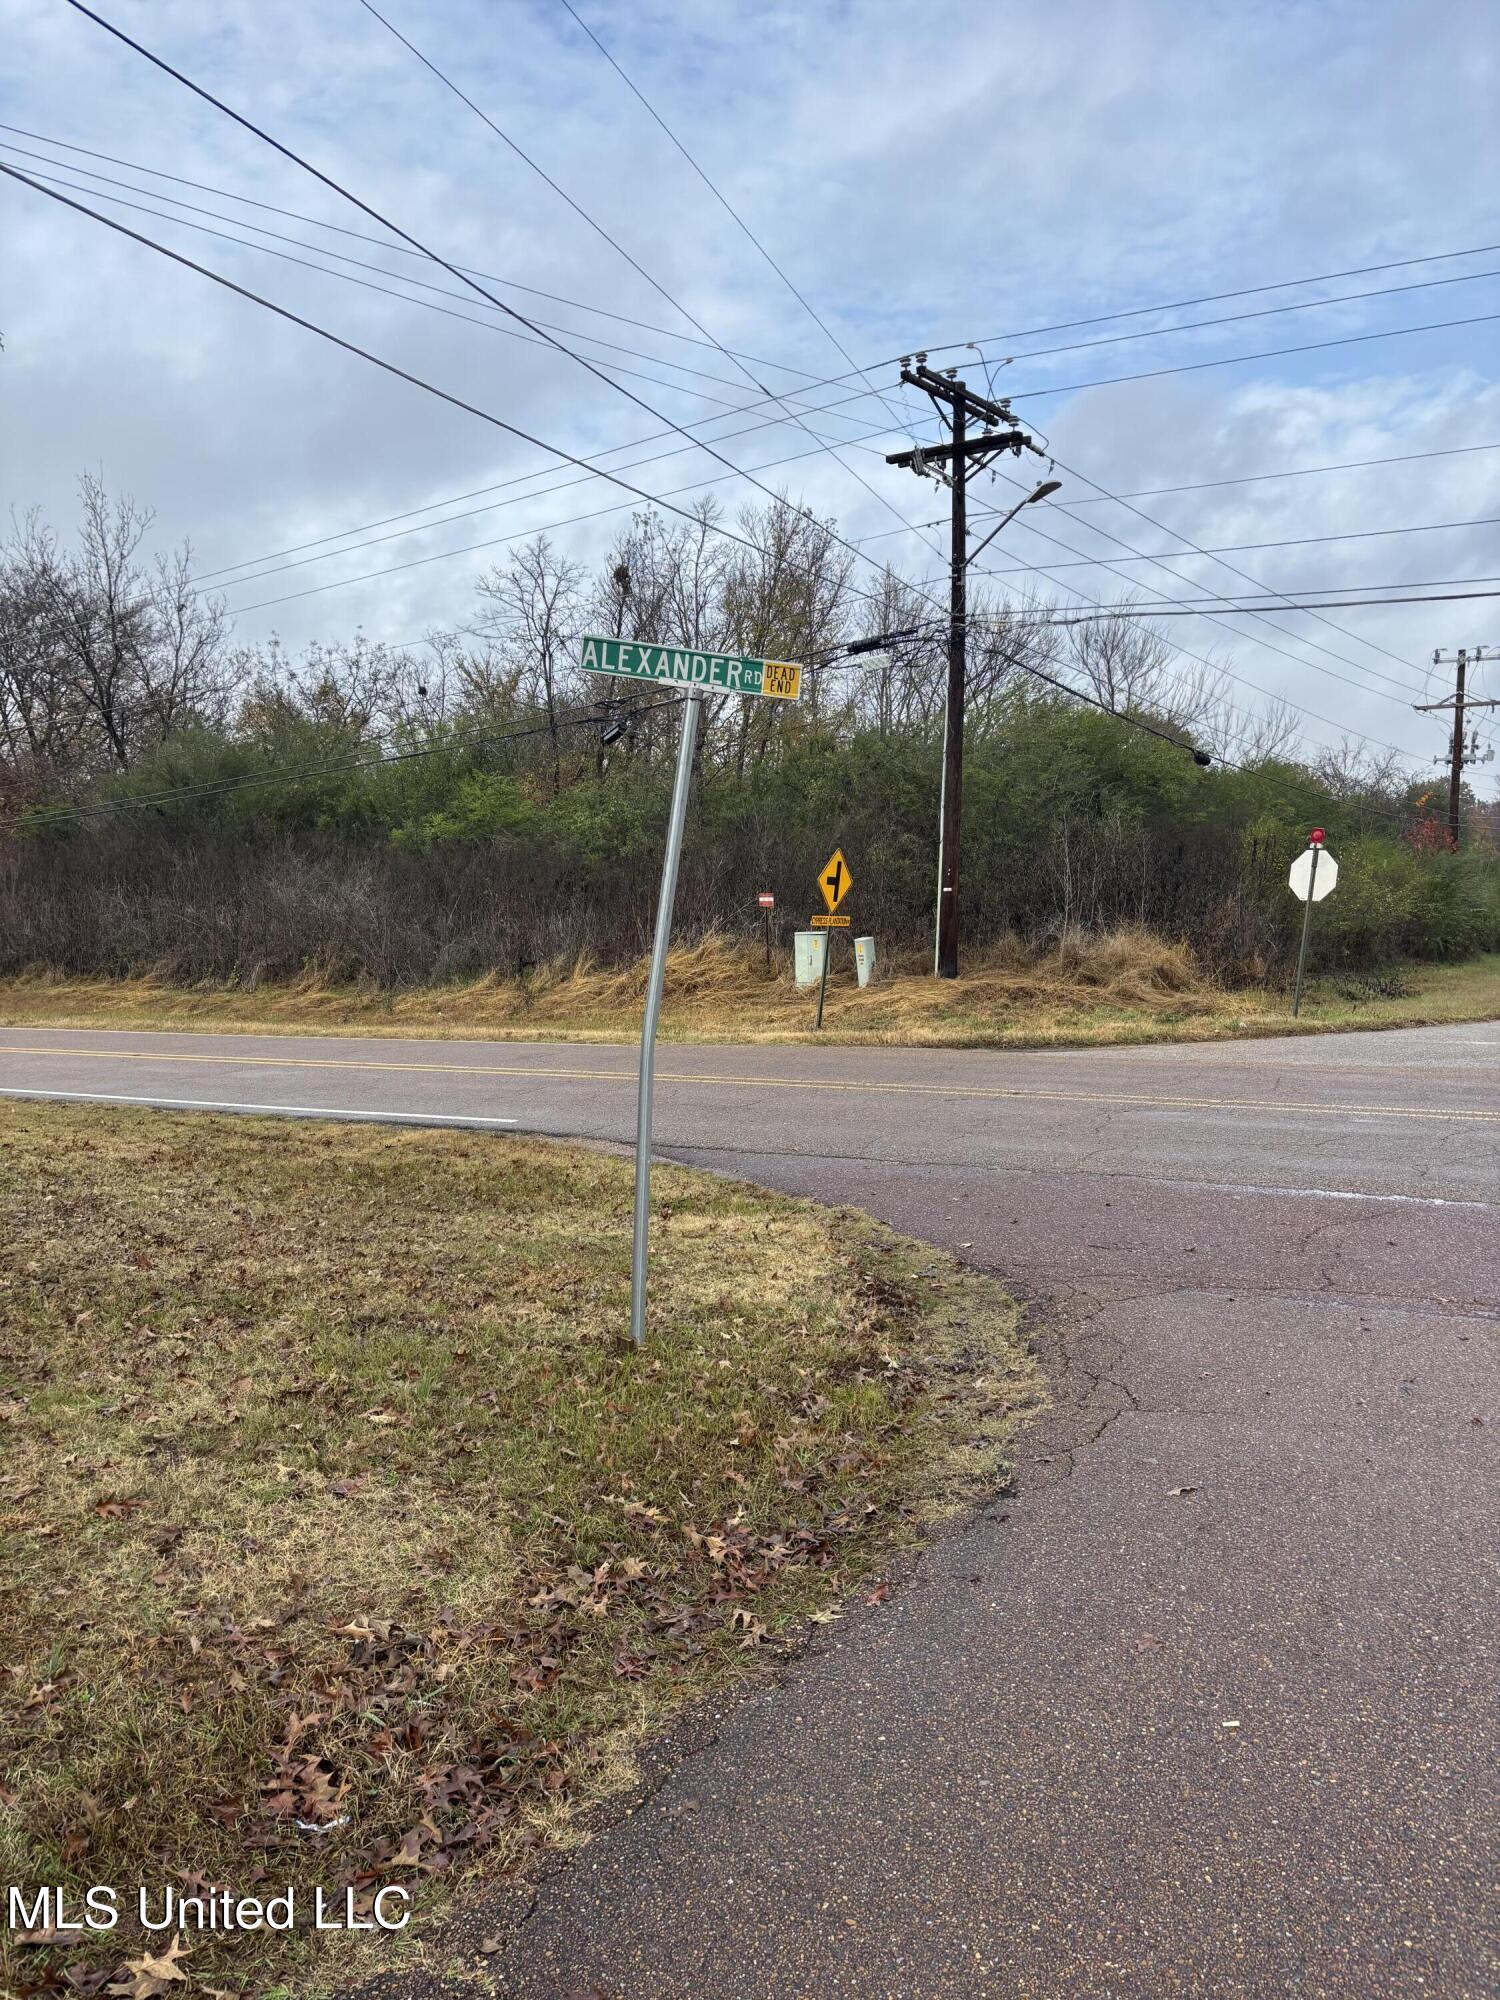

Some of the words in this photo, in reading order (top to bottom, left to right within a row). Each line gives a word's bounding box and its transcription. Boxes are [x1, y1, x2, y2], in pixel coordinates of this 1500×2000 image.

[582, 641, 743, 688] ALEXANDER
[744, 669, 762, 685] RD
[766, 666, 796, 681] DEAD
[770, 679, 791, 694] END
